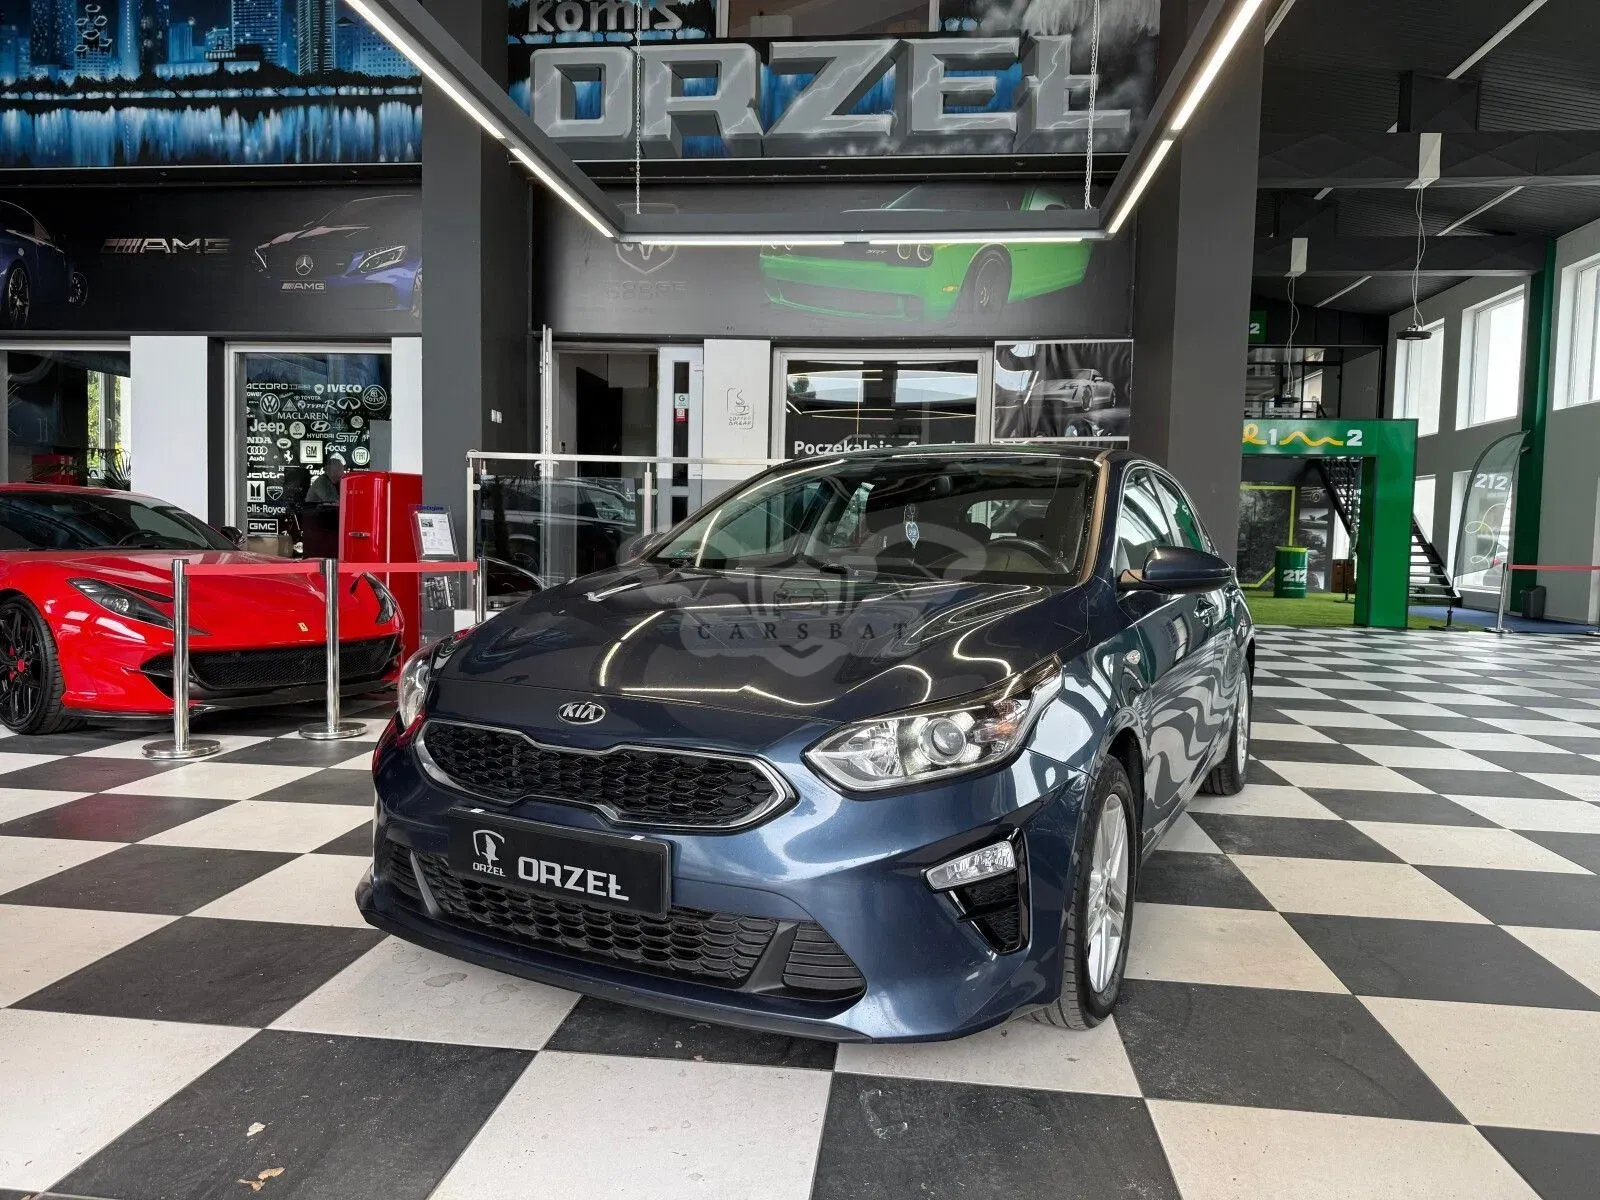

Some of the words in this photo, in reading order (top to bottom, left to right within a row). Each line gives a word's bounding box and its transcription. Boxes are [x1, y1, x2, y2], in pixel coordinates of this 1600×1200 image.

[528, 0, 683, 33] komis
[530, 35, 1132, 156] ORZEŁ
[294, 282, 325, 291] AMG
[327, 384, 363, 393] IVECO
[277, 412, 329, 420] MACLAREN
[249, 418, 284, 435] Jeep
[305, 445, 318, 455] GM
[1474, 472, 1508, 490] 212
[249, 522, 276, 530] GMC
[1282, 569, 1308, 584] 212
[561, 703, 597, 720] KIA
[517, 856, 630, 902] ORZEŁ
